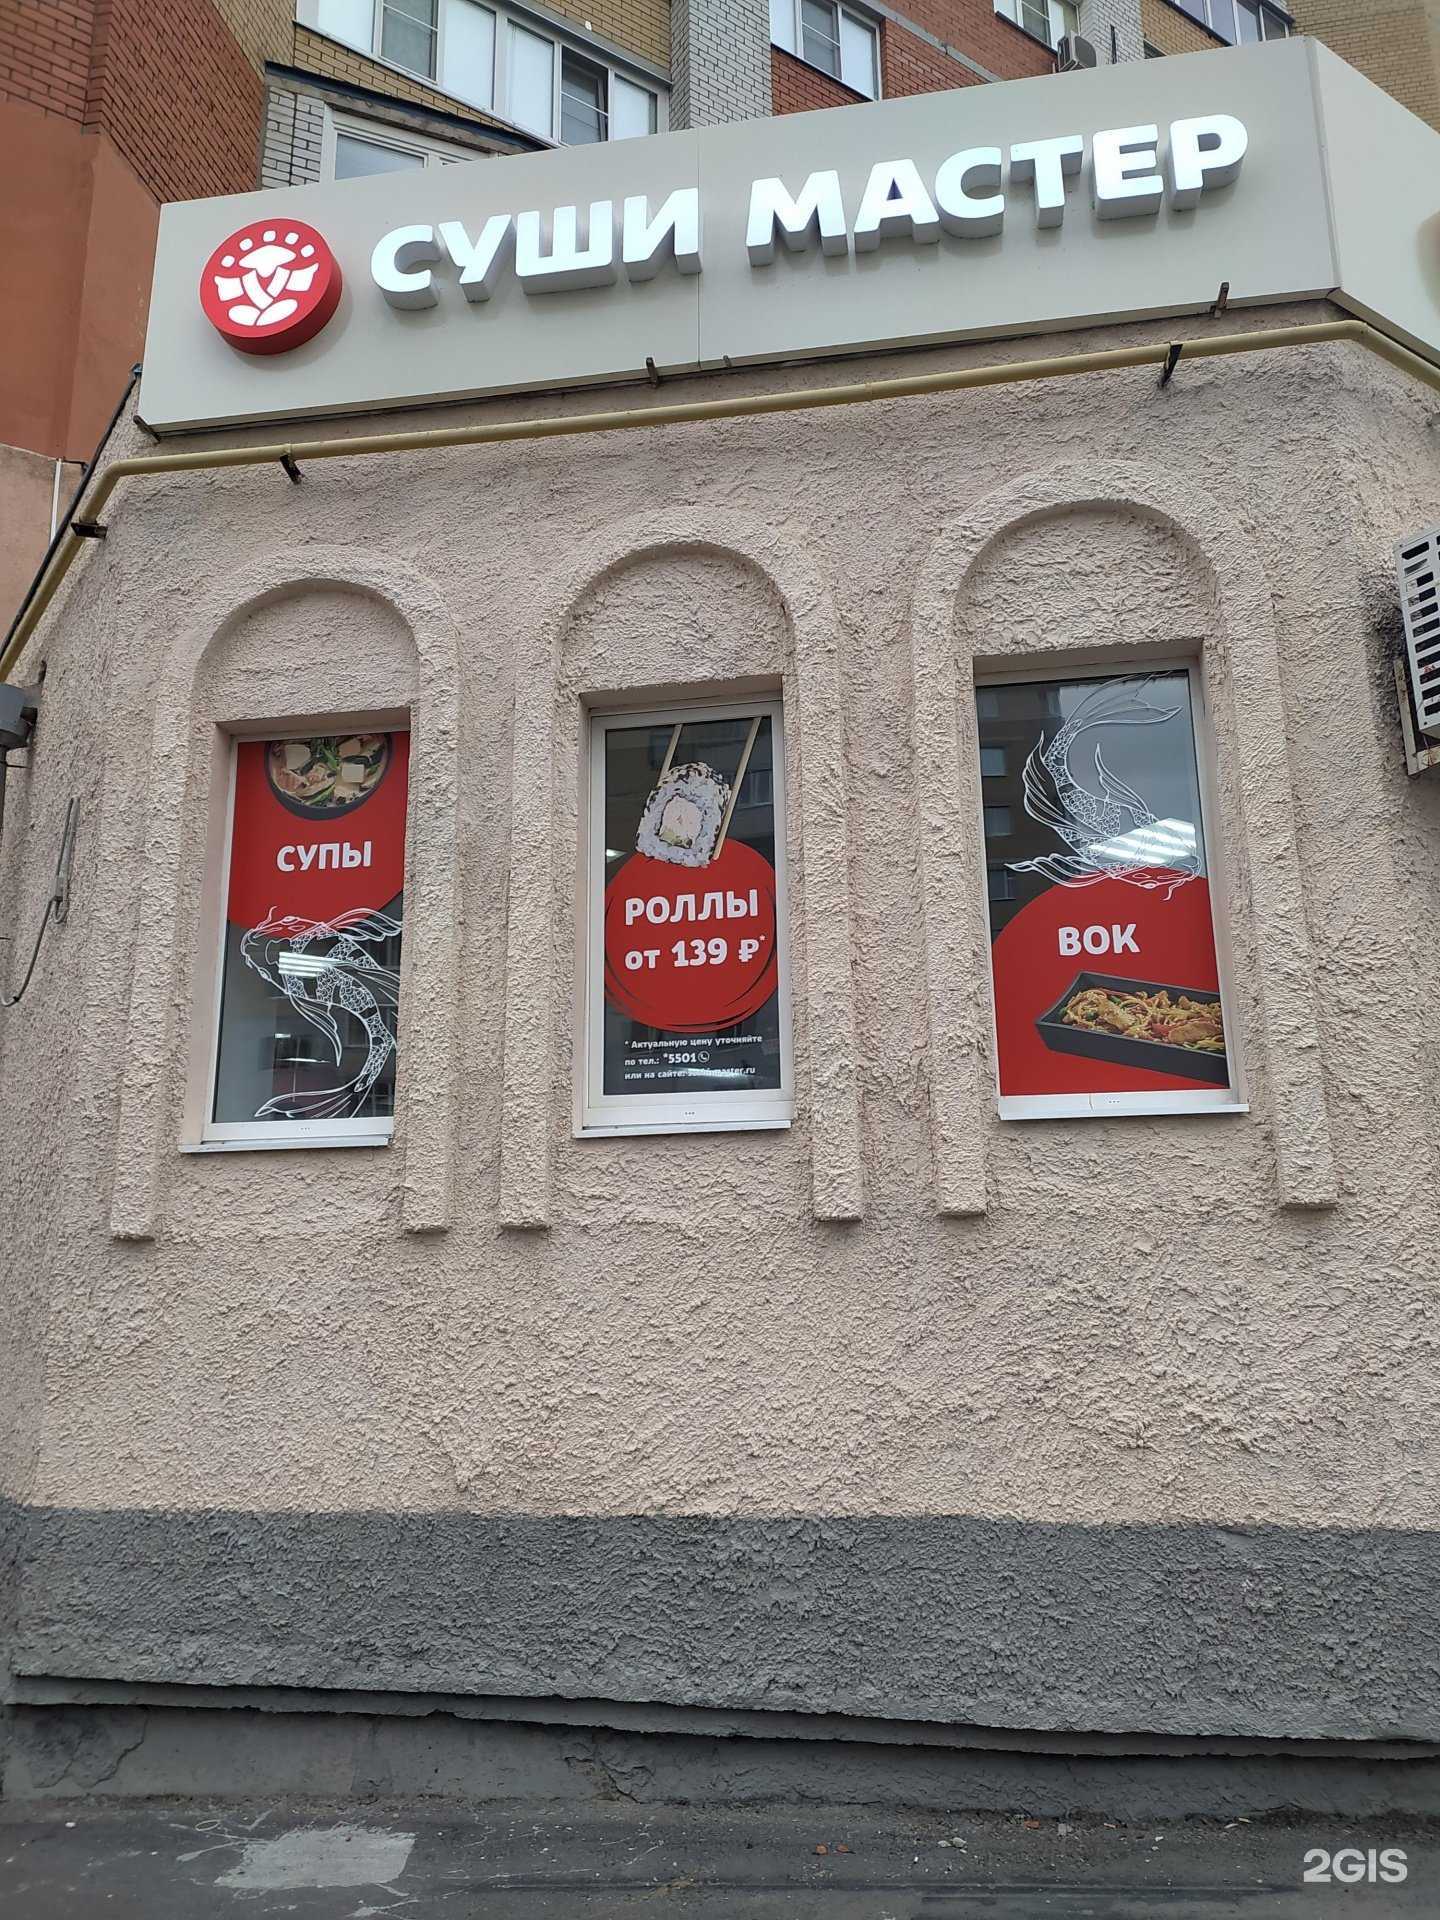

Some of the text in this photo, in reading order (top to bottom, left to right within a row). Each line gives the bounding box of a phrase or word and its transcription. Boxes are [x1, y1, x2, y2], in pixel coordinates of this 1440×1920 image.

[370, 114, 1249, 300] СУШИ МАСТЕР
[276, 840, 372, 872] СУПЫ
[625, 889, 758, 926] РОЛЛЫ
[671, 937, 728, 968] 139
[1058, 923, 1141, 956] ВОК
[631, 1039, 688, 1050] Актуальную
[690, 1038, 713, 1047] цену
[715, 1035, 763, 1046] уточняйте
[624, 1058, 636, 1066] по
[624, 1072, 642, 1080] или
